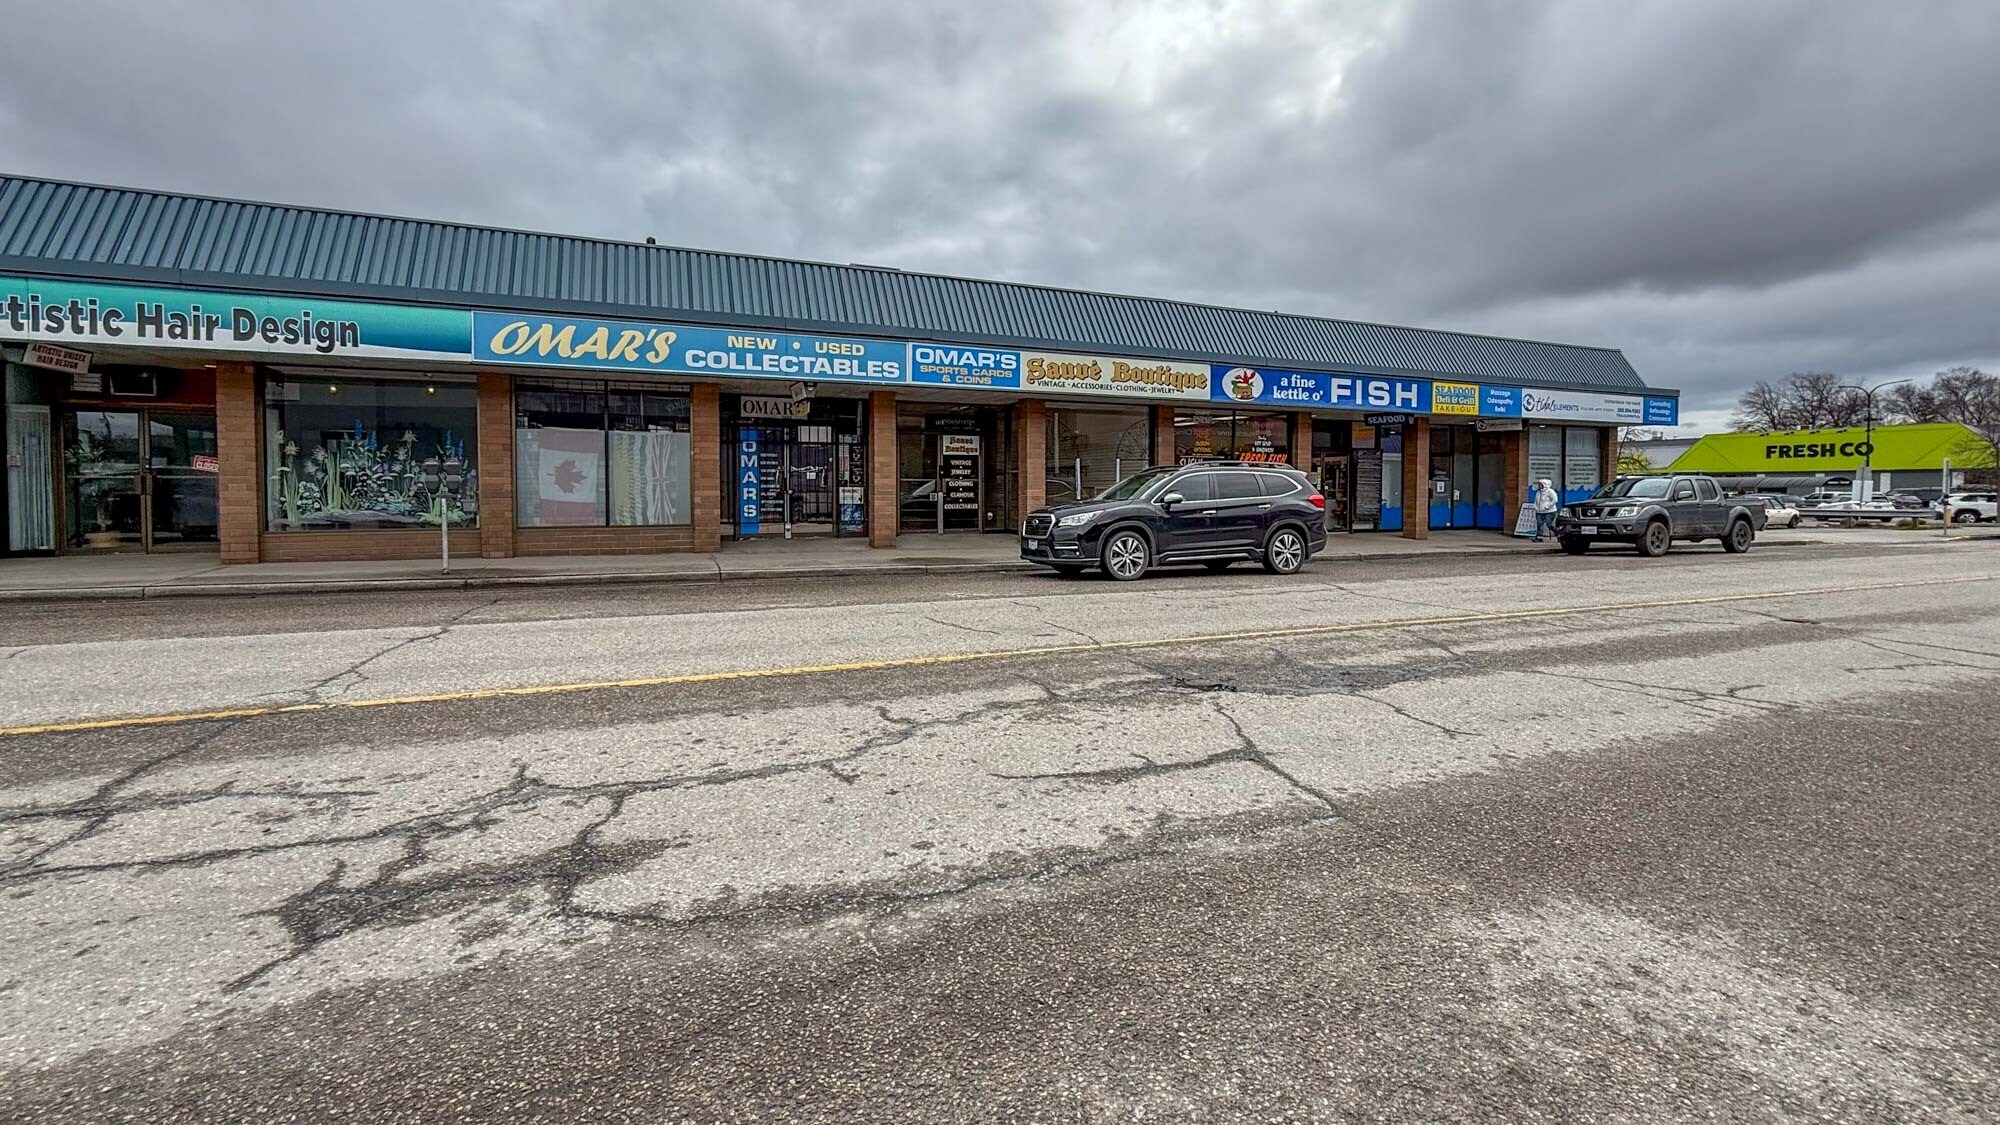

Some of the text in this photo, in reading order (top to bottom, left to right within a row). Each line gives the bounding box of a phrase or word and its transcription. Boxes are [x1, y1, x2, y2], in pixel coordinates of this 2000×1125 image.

[136, 301, 221, 341] Hair
[231, 307, 360, 353] Design
[490, 321, 865, 363] OMAR'S NEW USED
[32, 344, 86, 362] ARTISTIC UNISEX
[915, 348, 1018, 370] OMAR'S
[37, 355, 79, 369] HAIR DESIGN
[685, 349, 900, 378] COLLECTABLES
[920, 364, 1012, 378] SPORTS CARDS
[1112, 361, 1207, 393] Boutique
[942, 375, 992, 385] & COINS
[1037, 381, 1066, 389] VINTAGE
[1071, 382, 1113, 391] ACCESSORIES
[1116, 384, 1148, 393] CLOTHING
[1280, 374, 1315, 388] a fine
[1273, 386, 1310, 401] kettle
[1330, 377, 1418, 407] FISH
[1435, 386, 1476, 395] SEAFOOD
[1436, 395, 1475, 405] Deli & Grill
[1435, 405, 1476, 413] TAKE-OUT
[1367, 415, 1405, 424] SEAFOOD
[1766, 442, 1874, 458] FRESH CO
[1240, 452, 1288, 464] FRESH FISH
